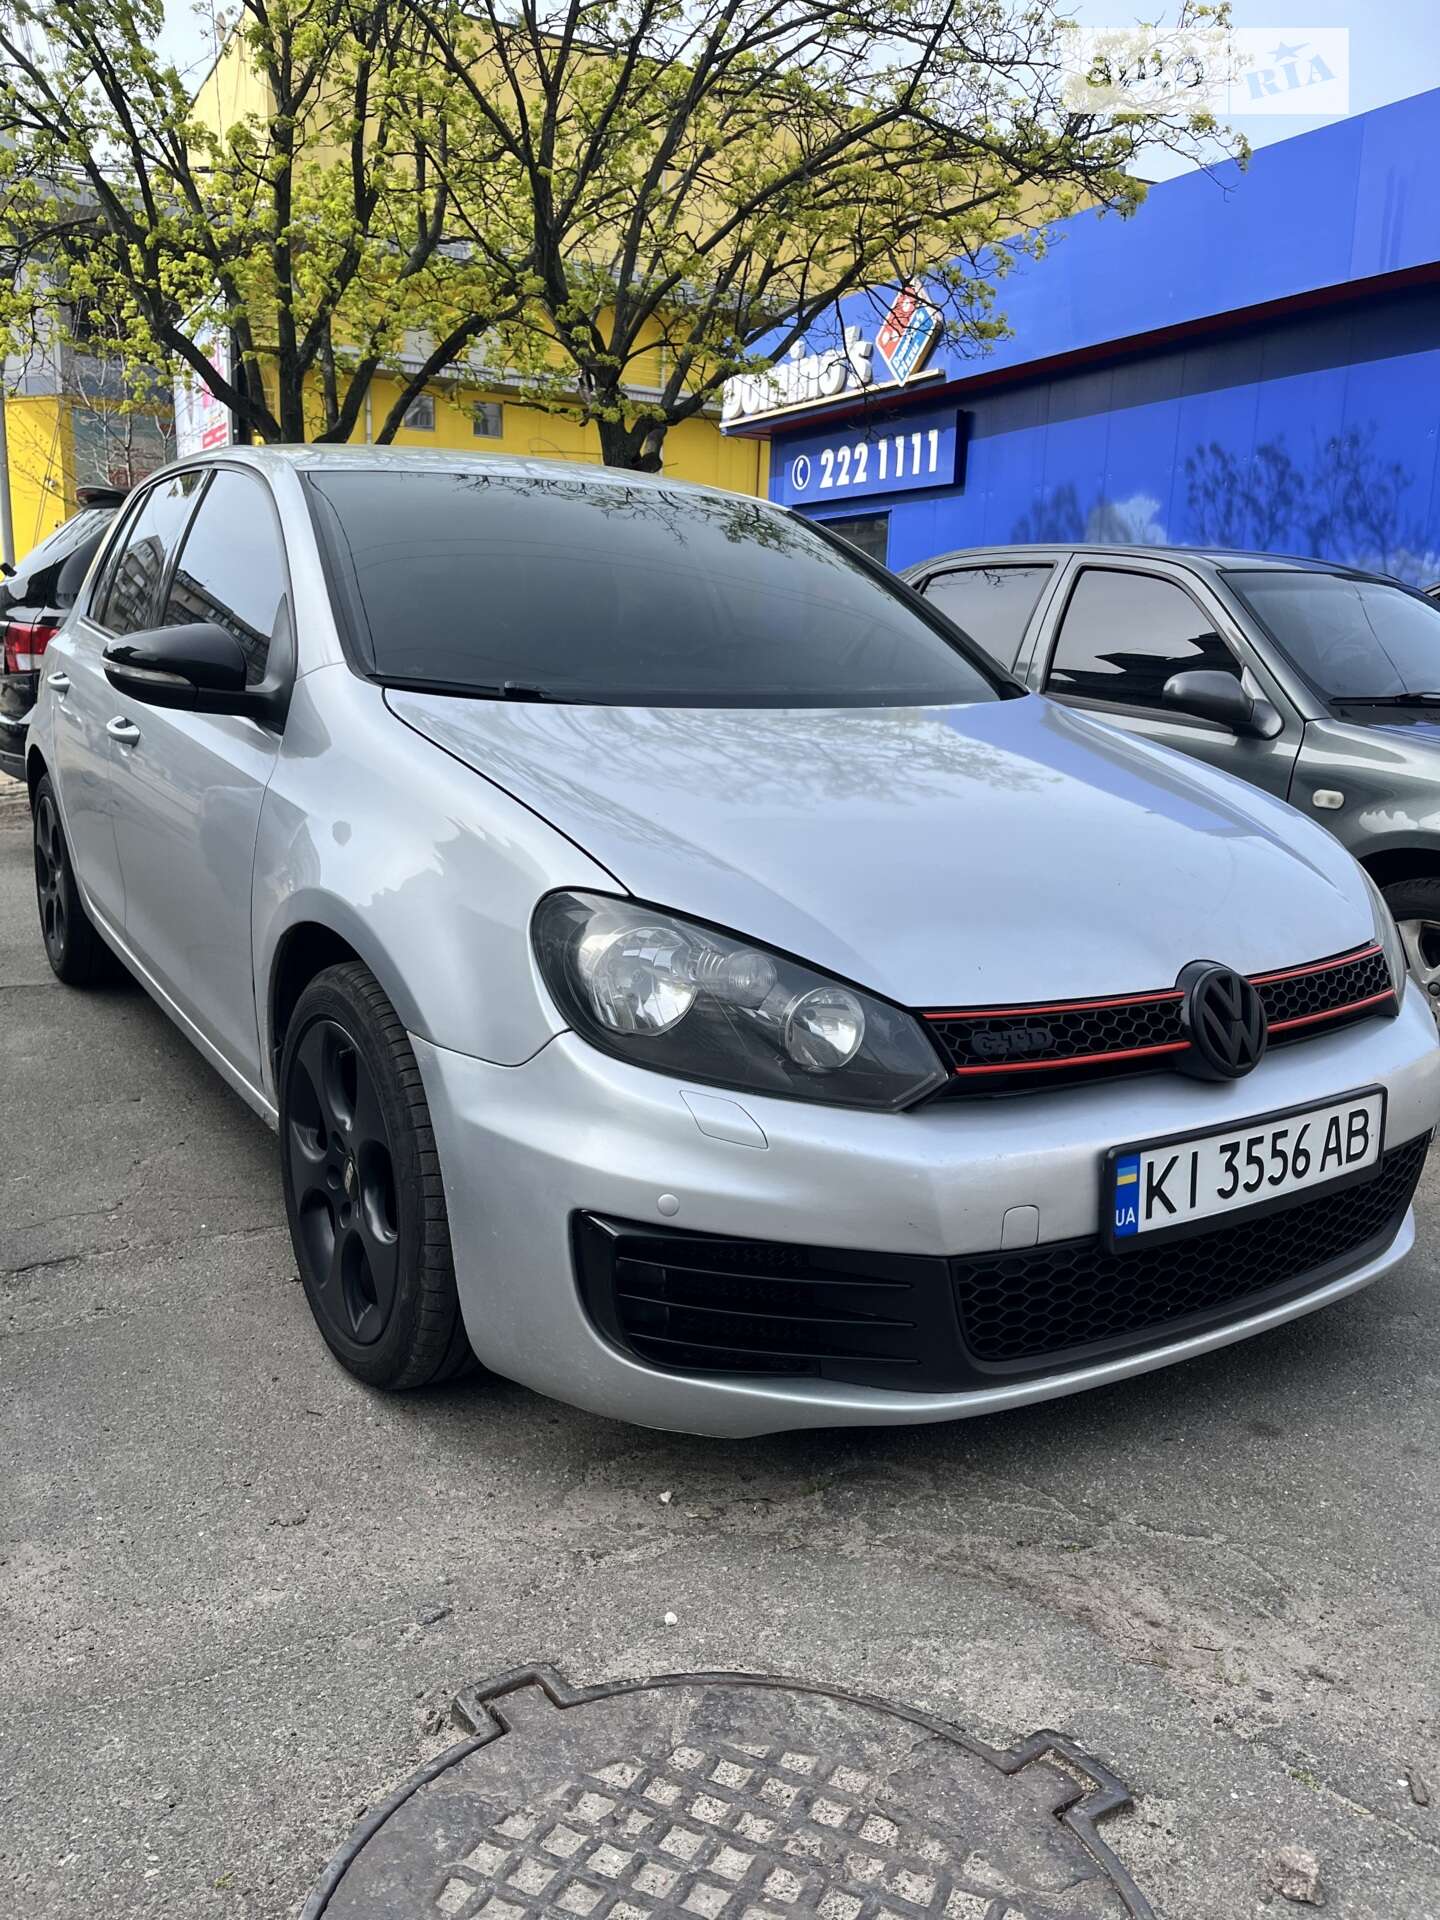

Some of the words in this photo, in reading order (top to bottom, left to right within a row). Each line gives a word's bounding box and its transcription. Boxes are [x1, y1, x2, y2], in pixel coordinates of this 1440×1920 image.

[820, 442, 869, 488] 222
[878, 429, 939, 480] 1111
[1145, 1150, 1199, 1220] KI
[1216, 1123, 1310, 1200] 3556
[1319, 1107, 1370, 1173] AB
[1115, 1208, 1136, 1227] UA
